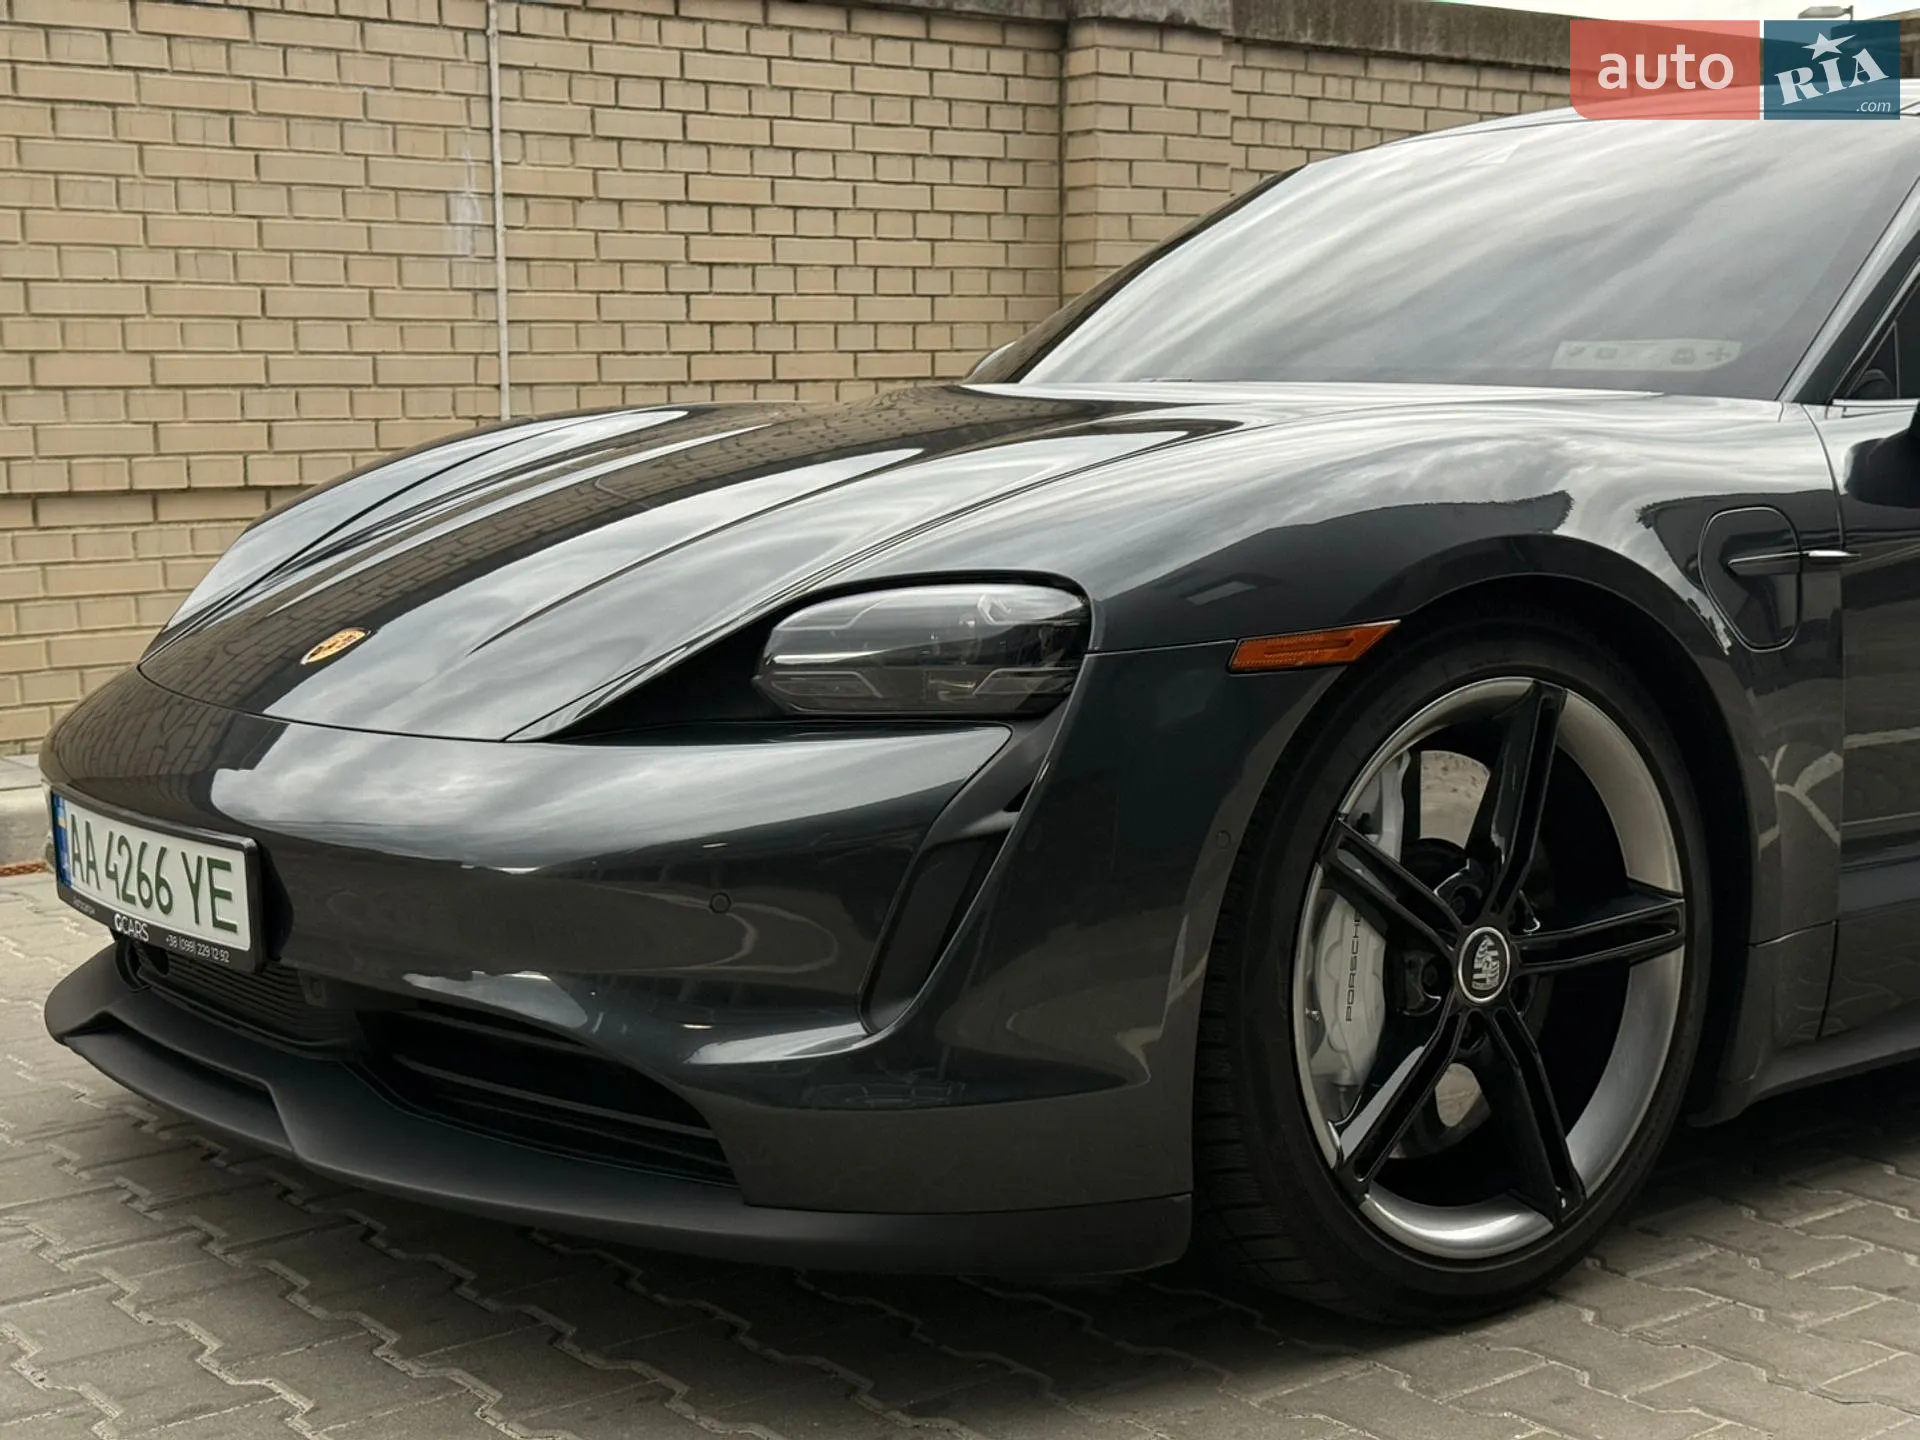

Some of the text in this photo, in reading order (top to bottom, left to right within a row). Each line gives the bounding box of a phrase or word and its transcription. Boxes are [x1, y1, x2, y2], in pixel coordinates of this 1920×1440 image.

[70, 813, 239, 934] AA 4266 YE
